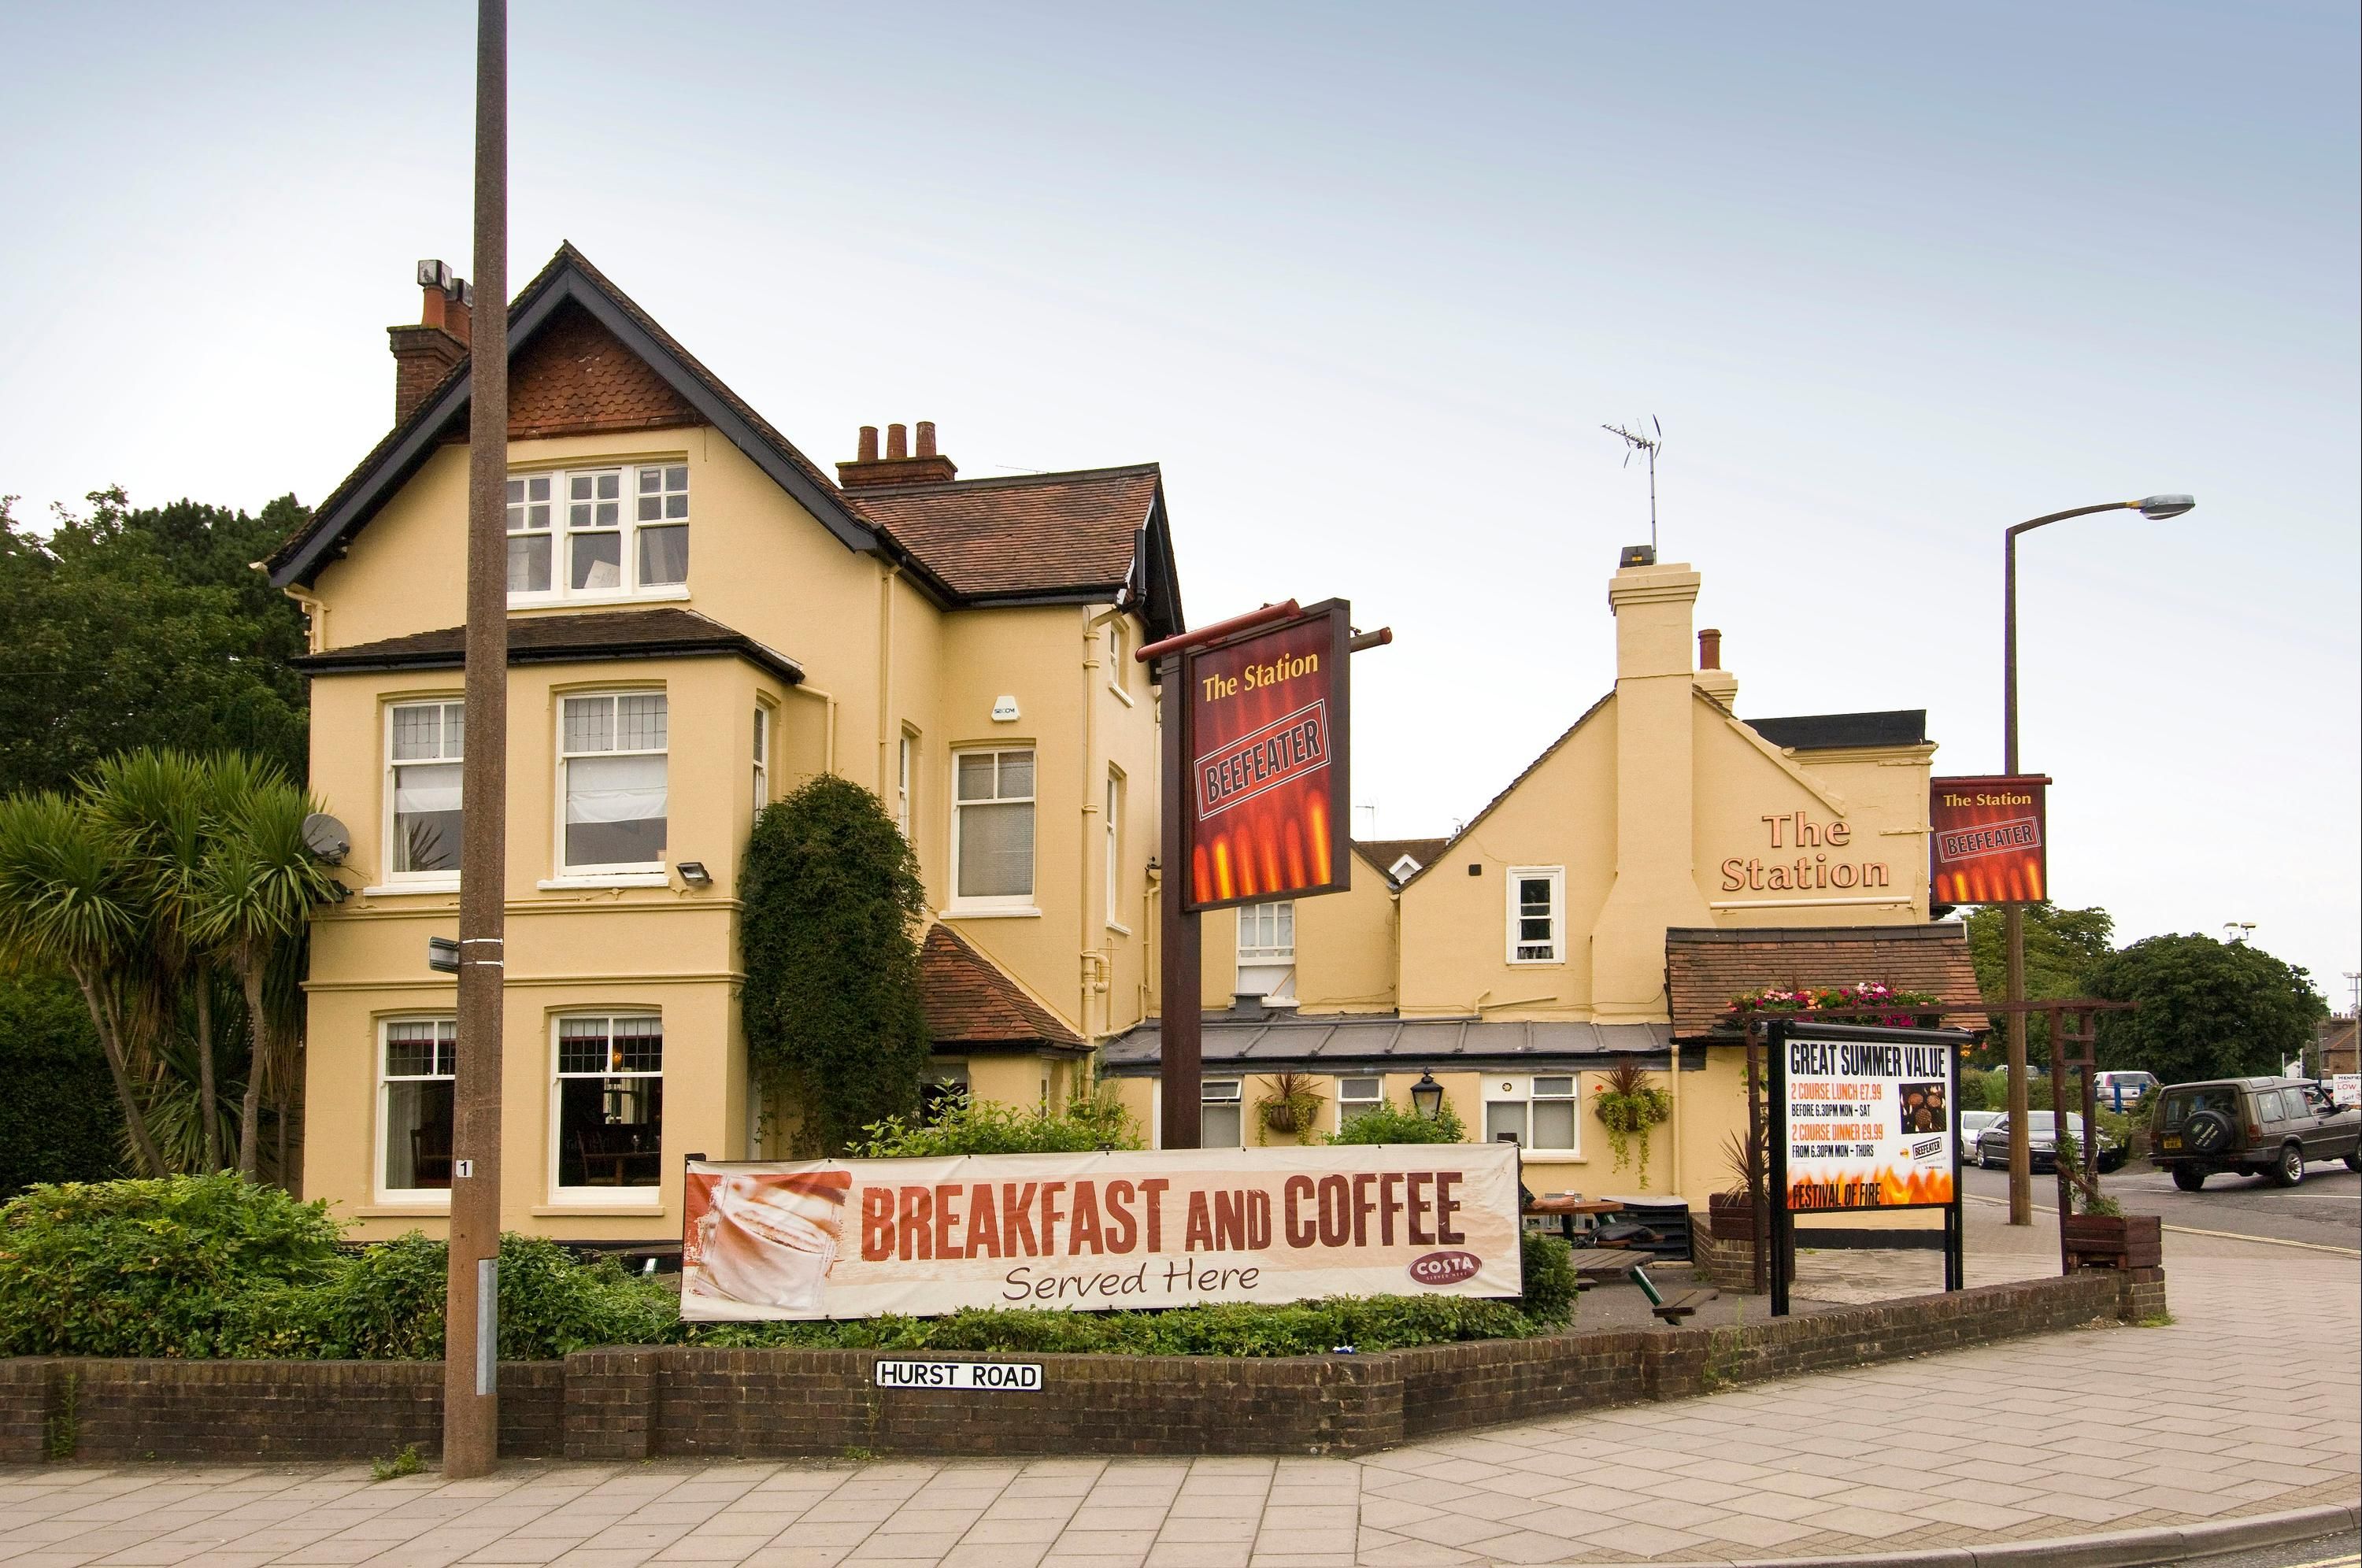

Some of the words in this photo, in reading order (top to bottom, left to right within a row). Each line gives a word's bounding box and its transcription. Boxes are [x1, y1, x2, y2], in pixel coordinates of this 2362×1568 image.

[1202, 674, 1238, 702] The
[1244, 653, 1319, 691] Station
[1205, 718, 1322, 804] BEEFEATER
[1942, 794, 1971, 808] The
[1975, 791, 2032, 807] Station
[1762, 812, 1851, 848] The
[1946, 823, 2034, 856] BEEFEATER
[1721, 852, 1890, 892] Station
[1790, 1043, 1837, 1076] GREAT
[1841, 1045, 1901, 1077] SUMMER
[1905, 1046, 1946, 1078] VALUE
[1791, 1082, 1797, 1100] 2
[1798, 1082, 1831, 1100] COURSE
[1831, 1083, 1858, 1100] LUNCH
[1791, 1104, 1814, 1117] BEFORE
[1816, 1104, 1838, 1117] 6.30PM
[1839, 1104, 1853, 1117] MON
[1860, 1104, 1871, 1117] SAT
[1792, 1123, 1797, 1141] 2
[1799, 1123, 1831, 1141] COURSE
[1832, 1123, 1860, 1141] DINNER
[1792, 1145, 1809, 1158] FROM
[1811, 1145, 1834, 1158] 6.30PM
[1834, 1145, 1849, 1158] MON
[1856, 1145, 1874, 1157] THURS
[1915, 1141, 1941, 1156] BEEFEATER
[461, 1161, 468, 1177] 1
[1793, 1183, 1842, 1208] FESTIVAL
[1844, 1183, 1858, 1207] OF
[1859, 1182, 1881, 1206] FIRE
[861, 1178, 1170, 1263] BREAKFAST
[1184, 1189, 1272, 1252] AND
[1284, 1171, 1466, 1249] COFFEE
[1416, 1256, 1475, 1275] COSTA
[1002, 1262, 1147, 1300] Served
[1163, 1258, 1260, 1293] Here
[881, 1363, 959, 1385] HURST
[972, 1366, 1036, 1387] ROAD
